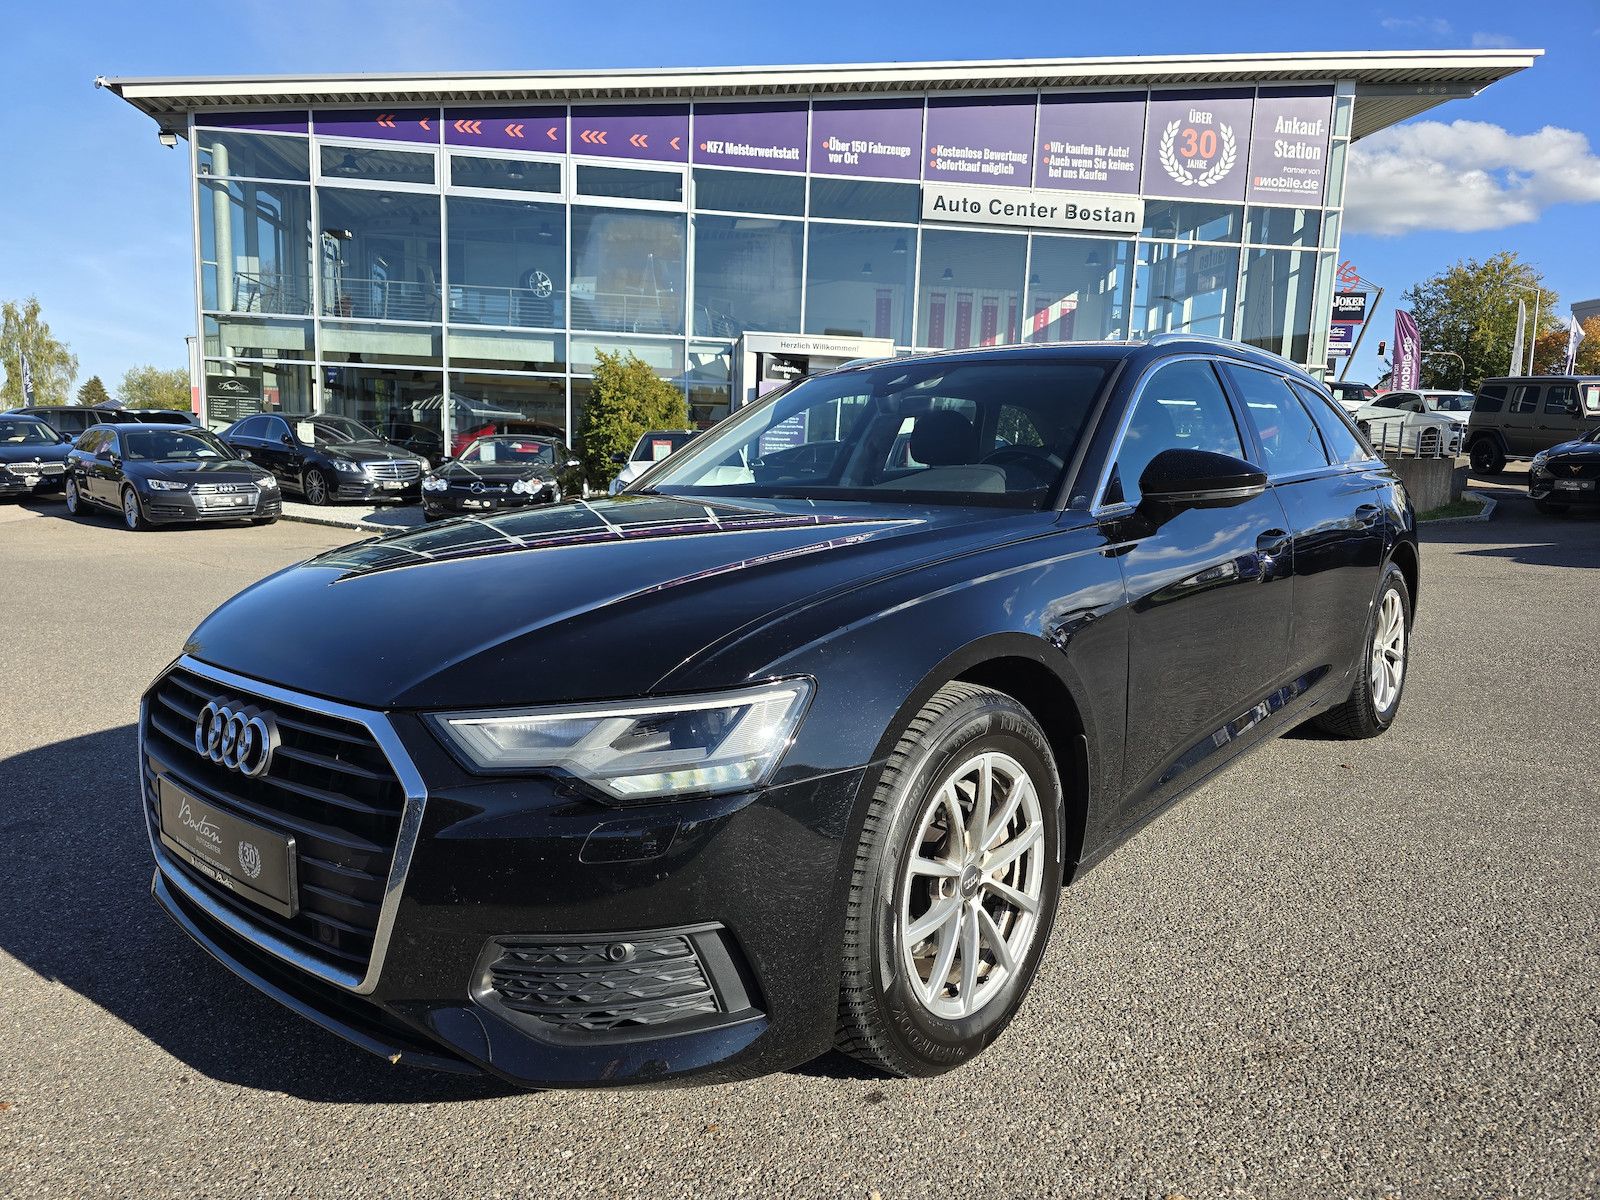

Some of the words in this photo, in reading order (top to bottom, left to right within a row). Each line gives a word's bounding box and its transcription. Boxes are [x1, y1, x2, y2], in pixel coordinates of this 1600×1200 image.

[1188, 108, 1212, 125] ÜBER
[1274, 115, 1325, 137] Ankauf-
[706, 140, 724, 154] KFZ
[724, 142, 799, 160] Meisterwerkstatt
[829, 136, 850, 152] Über
[851, 140, 867, 154] 150
[868, 142, 911, 157] Fahrzeuge
[1050, 141, 1065, 154] Wir
[1066, 142, 1094, 156] kaufen
[1094, 144, 1107, 157] Ihr
[1108, 145, 1130, 158] Auto!
[1180, 128, 1217, 159] 30
[1274, 139, 1321, 160] Station
[829, 153, 843, 164] vor
[844, 152, 859, 165] Ort
[936, 145, 982, 161] Kostenlose
[983, 148, 1028, 164] Bewertung
[936, 158, 981, 173] Sofortkauf
[981, 161, 1014, 176] möglich
[1049, 156, 1070, 168] Auch
[1071, 157, 1092, 169] wenn
[1093, 157, 1107, 170] Sie
[1107, 159, 1135, 172] keines
[1186, 158, 1208, 170] JAHRE
[1283, 166, 1307, 175] Partner
[1049, 166, 1062, 178] bei
[1062, 168, 1078, 179] uns
[1078, 168, 1108, 181] Kaufen
[932, 195, 982, 214] Auto
[988, 199, 1058, 219] Center
[1065, 203, 1136, 223] Bostan
[1333, 295, 1365, 308] JOKER
[780, 341, 811, 351] Herzlich
[812, 342, 859, 352] Willkommen!
[178, 797, 222, 844] Bostan
